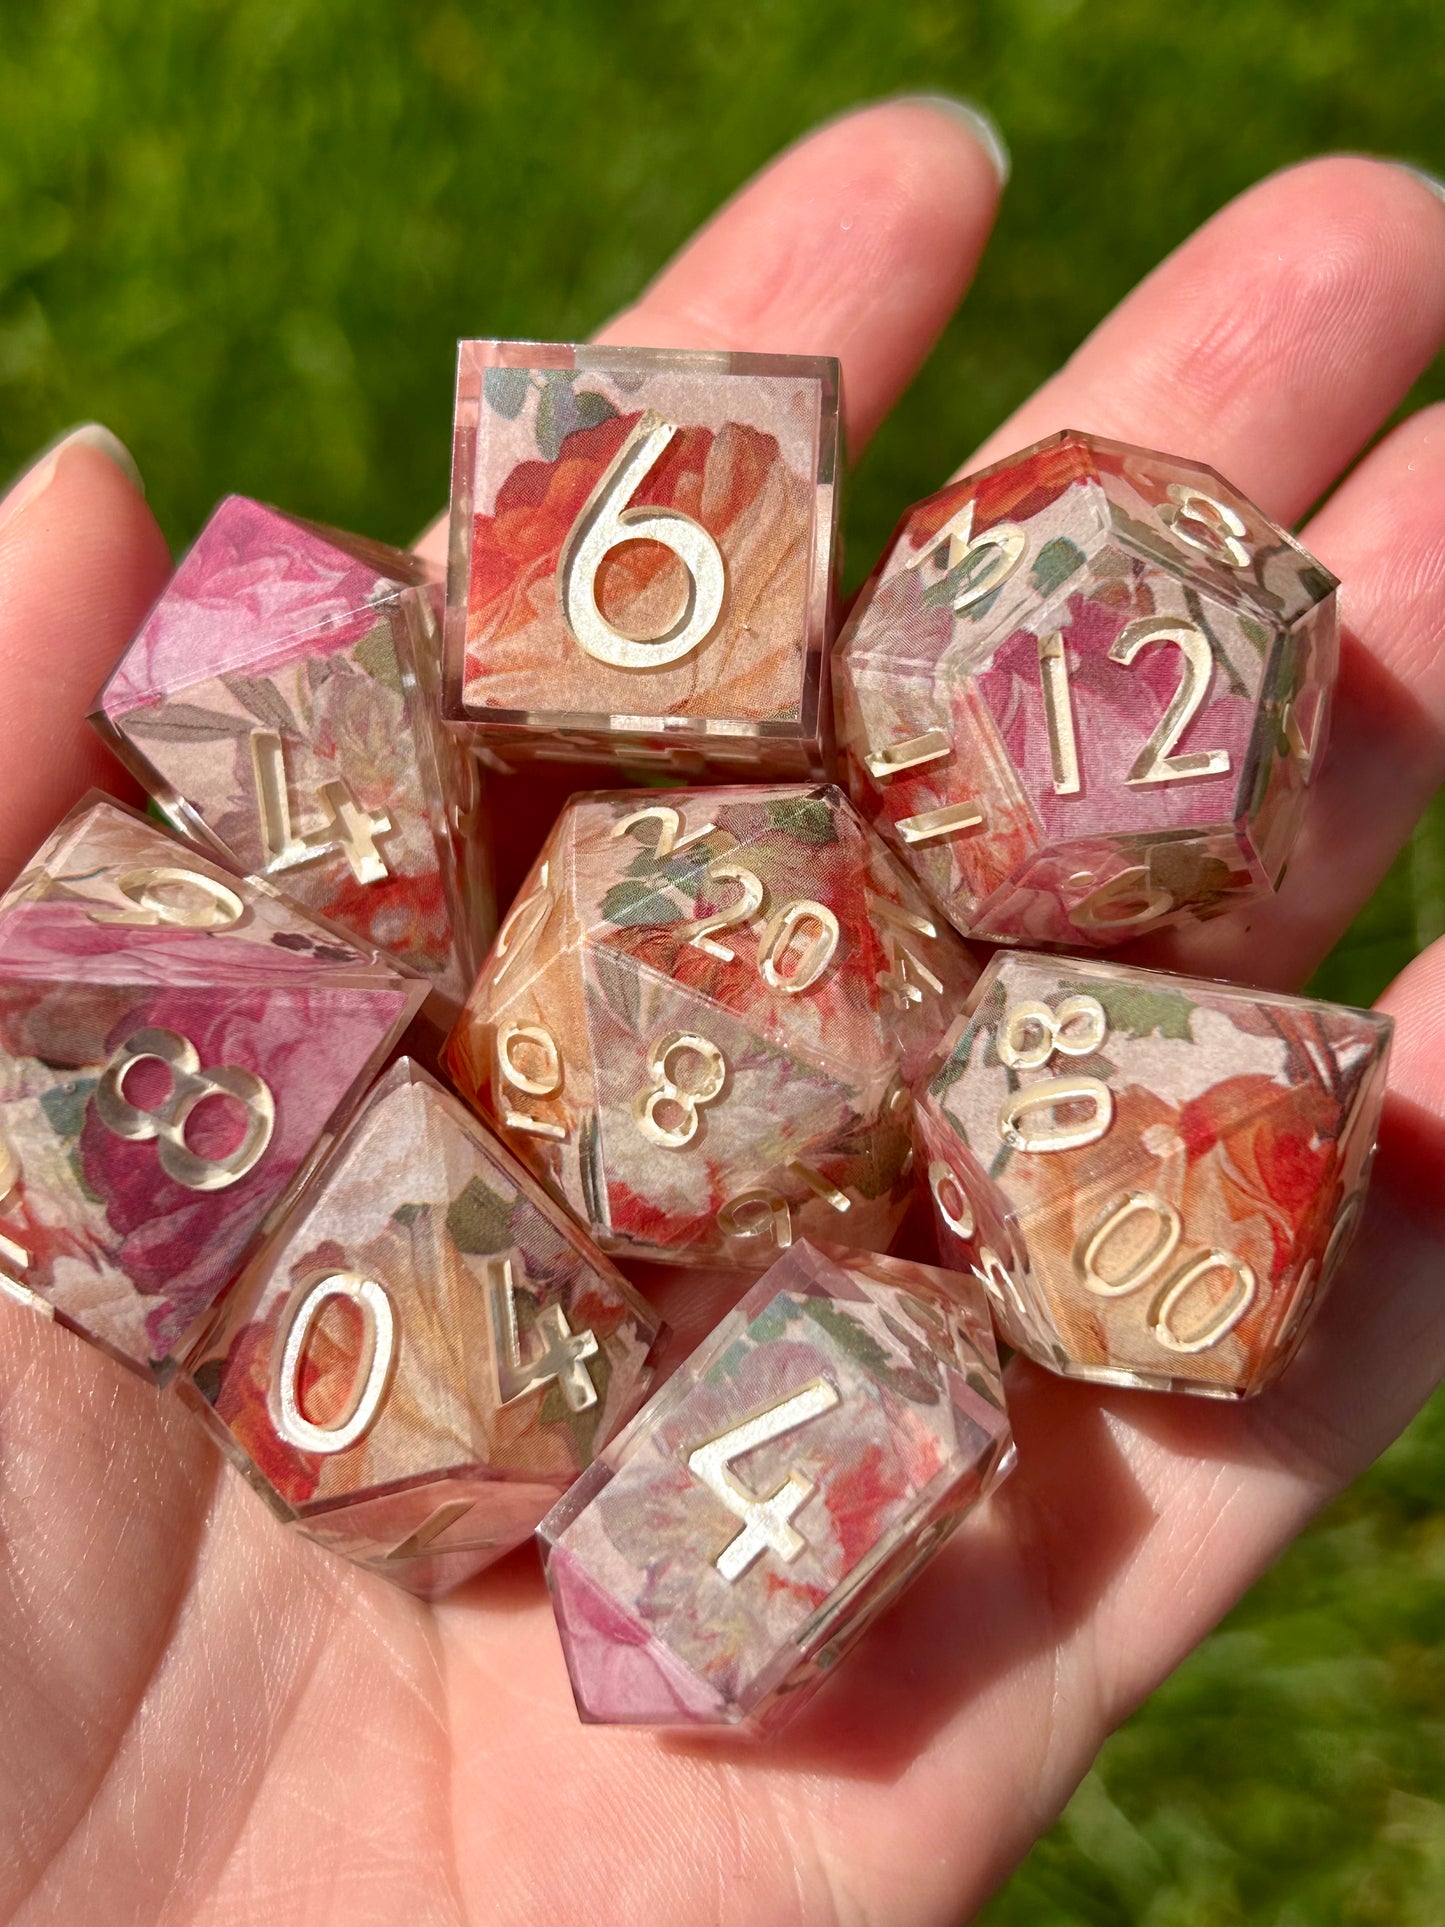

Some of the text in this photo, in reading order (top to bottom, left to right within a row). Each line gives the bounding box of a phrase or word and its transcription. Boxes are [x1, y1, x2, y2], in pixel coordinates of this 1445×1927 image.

[556, 408, 725, 668] 6
[1036, 615, 1231, 796] 12
[250, 727, 393, 886] 4
[610, 806, 717, 861] 2
[674, 863, 840, 995] 20
[97, 1027, 275, 1192] 8
[498, 1021, 567, 1139] 10
[632, 1030, 727, 1149] 8
[998, 995, 1114, 1154] 80
[487, 1258, 600, 1414] 4
[1071, 1189, 1257, 1354] 00
[270, 1267, 395, 1454] 0
[687, 1376, 840, 1584] 4
